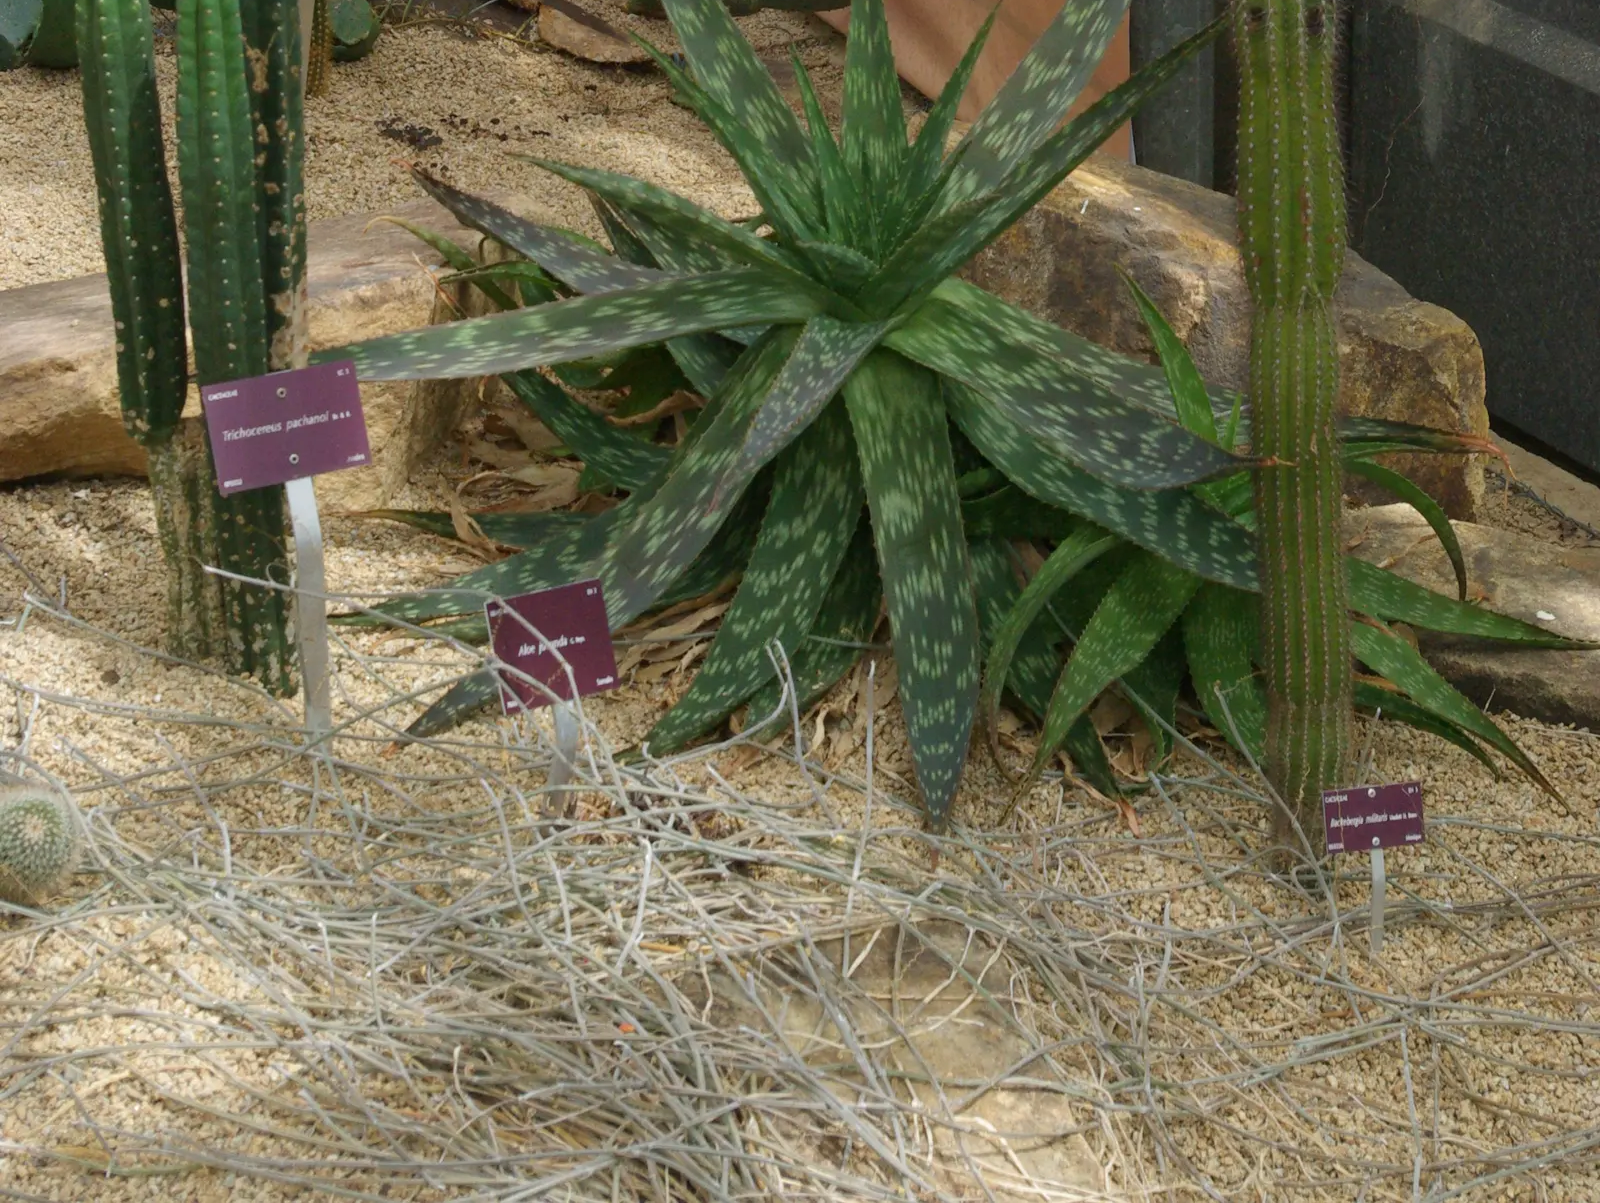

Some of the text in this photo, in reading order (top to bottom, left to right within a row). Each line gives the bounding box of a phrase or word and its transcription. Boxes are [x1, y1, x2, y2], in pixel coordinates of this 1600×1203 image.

[222, 421, 283, 441] Trichocereus
[285, 410, 329, 432] pachanoi
[518, 642, 536, 657] Aloe
